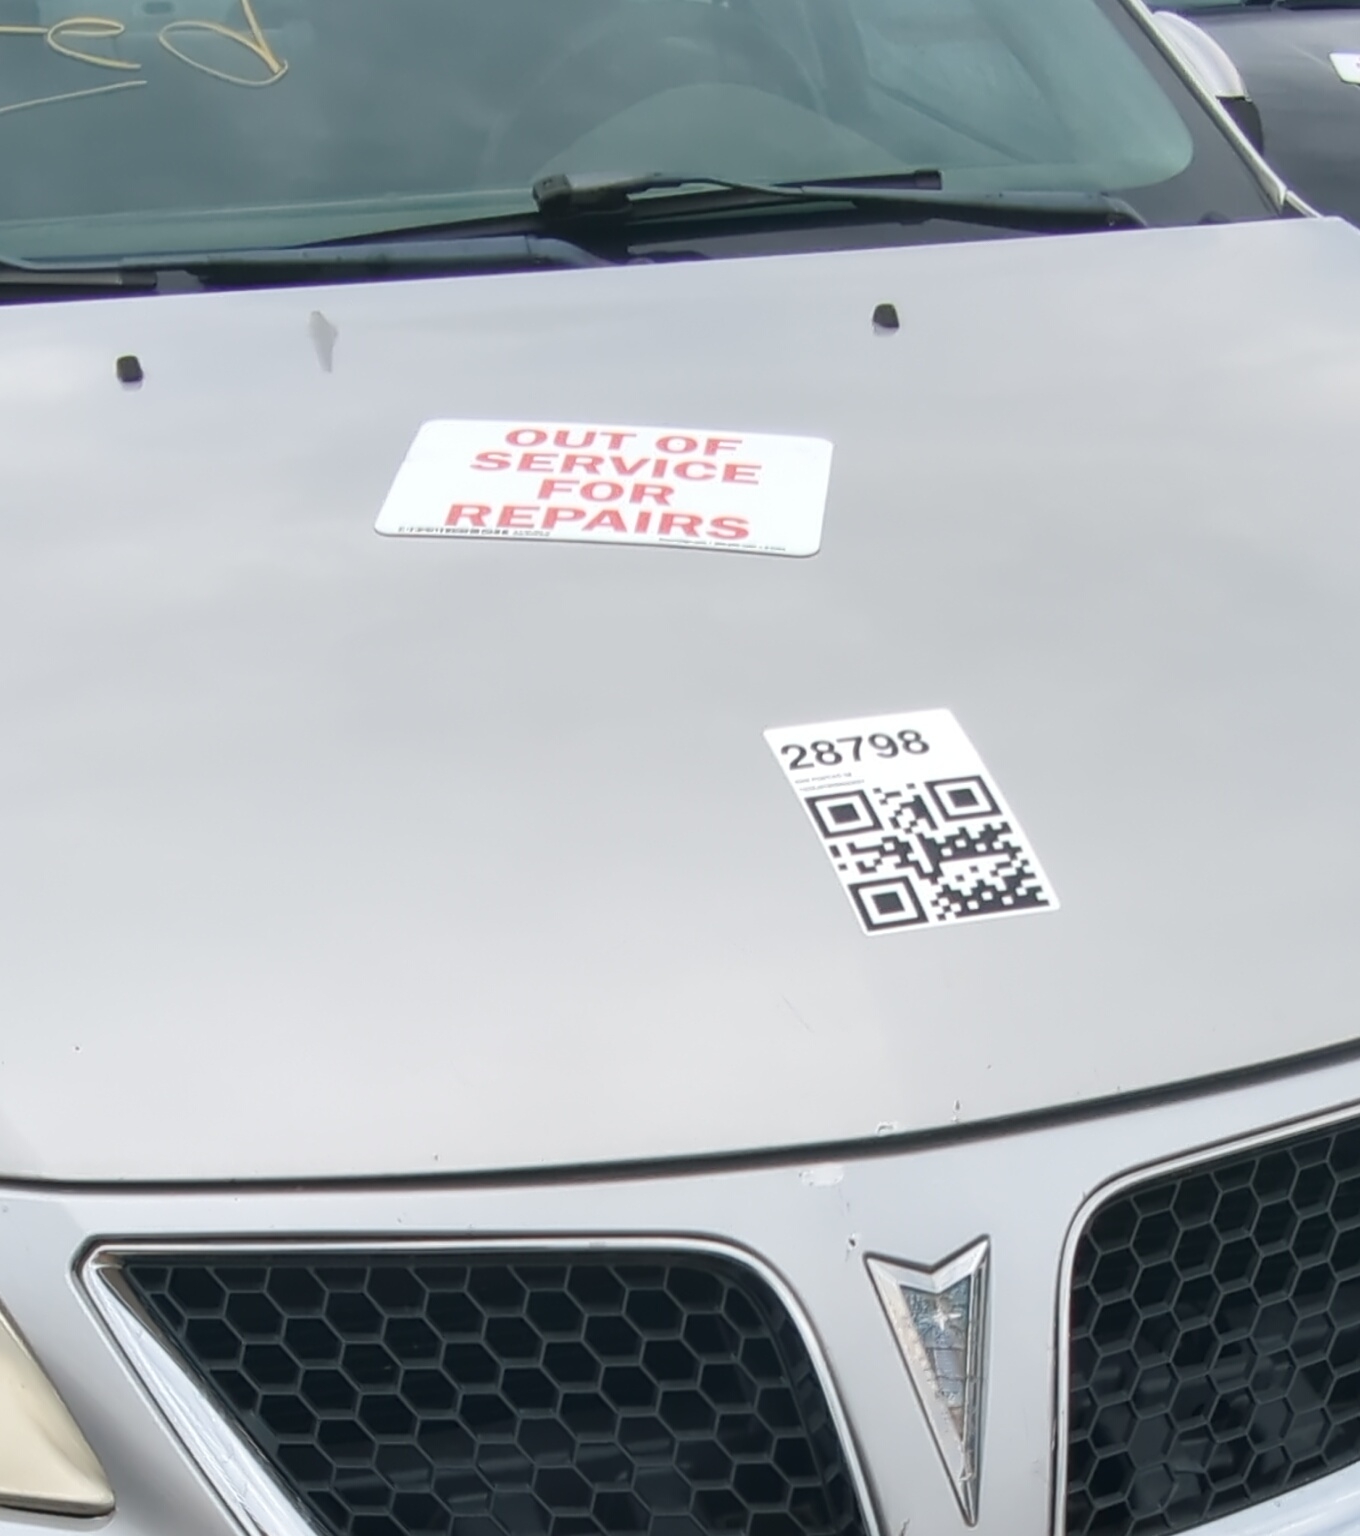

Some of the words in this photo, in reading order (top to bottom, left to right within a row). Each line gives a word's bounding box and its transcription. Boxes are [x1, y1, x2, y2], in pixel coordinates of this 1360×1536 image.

[505, 428, 637, 450] OUT
[655, 434, 744, 457] OF
[469, 451, 763, 485] SERVICE
[537, 478, 676, 506] FOR
[444, 503, 751, 541] REPAIRS
[780, 729, 931, 770] 28798
